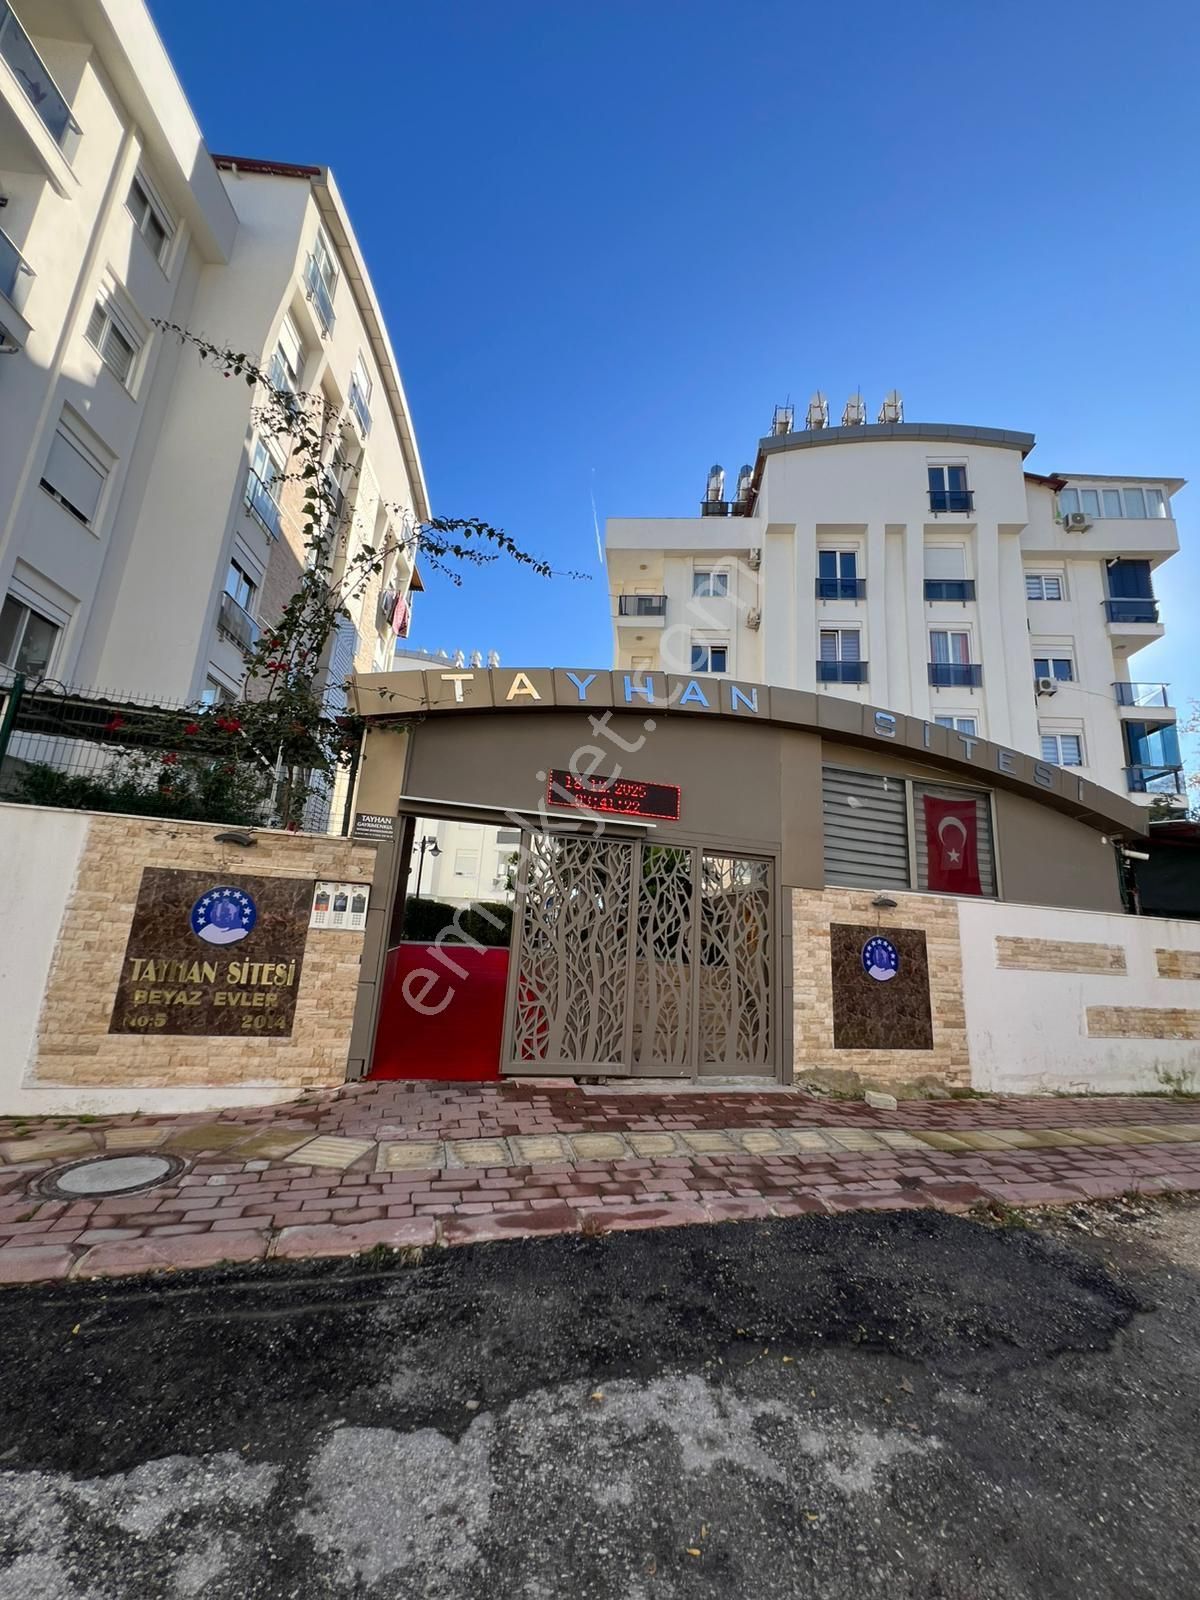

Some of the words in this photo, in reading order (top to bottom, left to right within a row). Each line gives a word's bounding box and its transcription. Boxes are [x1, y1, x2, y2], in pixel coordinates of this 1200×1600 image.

[441, 671, 759, 714] TAYHAN
[361, 815, 392, 824] TAYHAN
[129, 957, 218, 984] TAYHAN
[226, 956, 296, 986] SİTESİ
[134, 989, 204, 1006] BEYAZ
[213, 991, 279, 1007] EVLER
